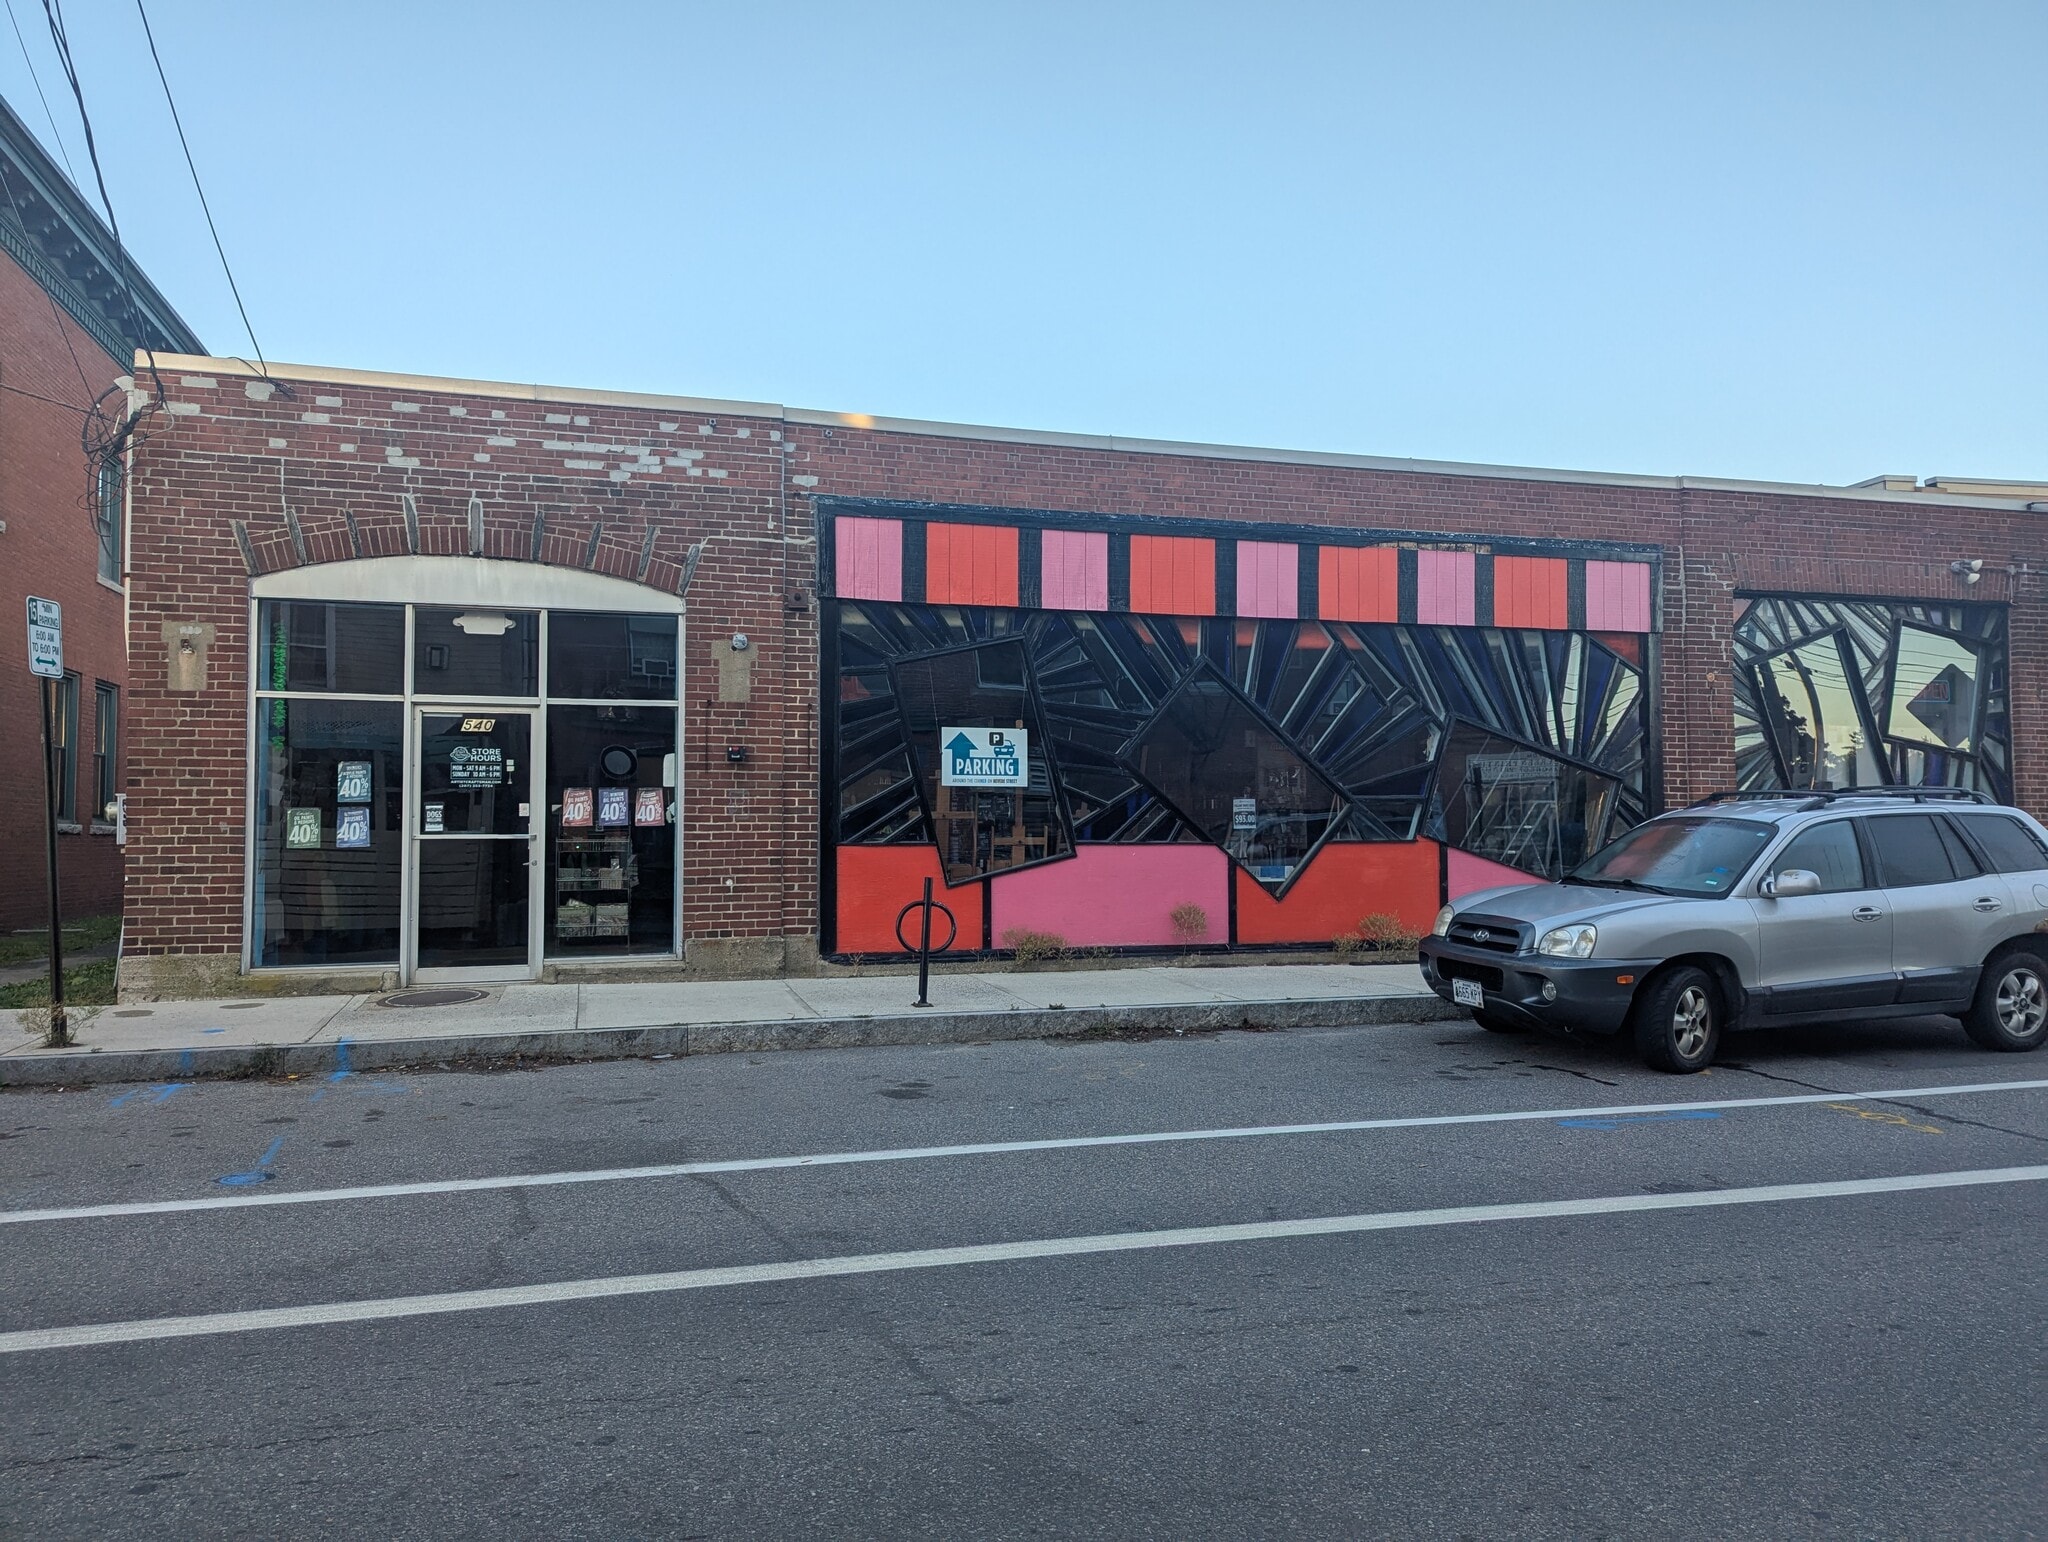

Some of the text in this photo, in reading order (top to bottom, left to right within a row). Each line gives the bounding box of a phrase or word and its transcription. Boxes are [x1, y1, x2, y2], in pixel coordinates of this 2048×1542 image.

[29, 601, 37, 620] 15
[39, 615, 59, 627] PARKING
[47, 633, 55, 642] AM
[32, 642, 39, 652] TO
[52, 646, 60, 656] PM
[464, 720, 493, 731] 540
[993, 734, 1000, 744] P
[956, 758, 1014, 775] PARKING
[340, 778, 368, 797] 40%
[566, 800, 590, 820] 40%
[600, 802, 626, 821] 40%
[638, 802, 662, 822] 40%
[1235, 815, 1255, 823] $93.00
[289, 823, 319, 843] 40%
[338, 821, 367, 841] 40%
